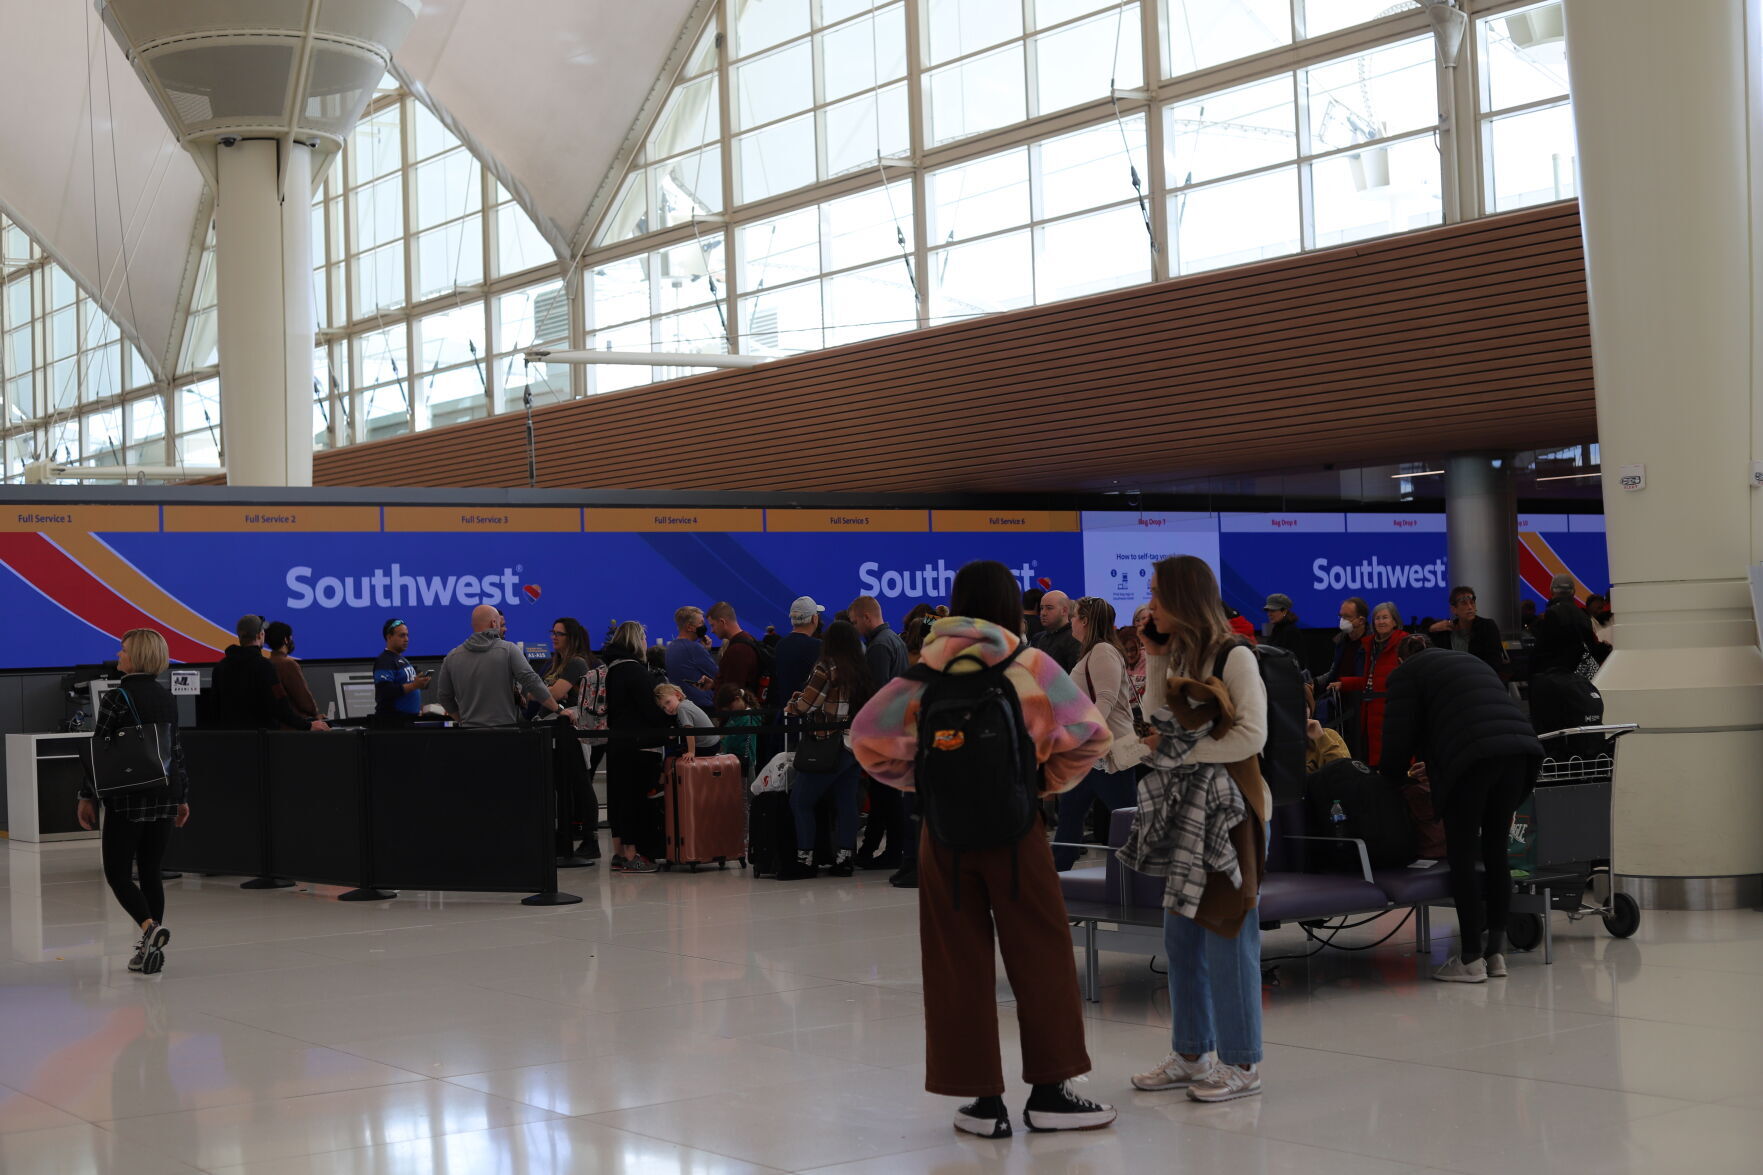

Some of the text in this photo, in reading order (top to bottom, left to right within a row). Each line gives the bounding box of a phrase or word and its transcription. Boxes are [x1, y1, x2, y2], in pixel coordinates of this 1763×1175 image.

[18, 514, 72, 523] Full Service 1
[245, 514, 296, 523] Full Service 2
[461, 515, 509, 524] Full Service 3
[654, 516, 667, 524] Full
[668, 516, 692, 524] Service
[830, 517, 869, 525] Full Service 5
[1138, 519, 1148, 527] Bag
[1149, 519, 1162, 527] Drop
[1272, 520, 1281, 528] Bag
[1281, 520, 1293, 528] Drop
[1393, 520, 1402, 528] Bag
[1403, 520, 1413, 528] Drop
[1138, 553, 1159, 561] self-tag
[1312, 555, 1447, 590] Southwest
[858, 559, 1035, 598] Southt
[286, 563, 520, 609] Southwest
